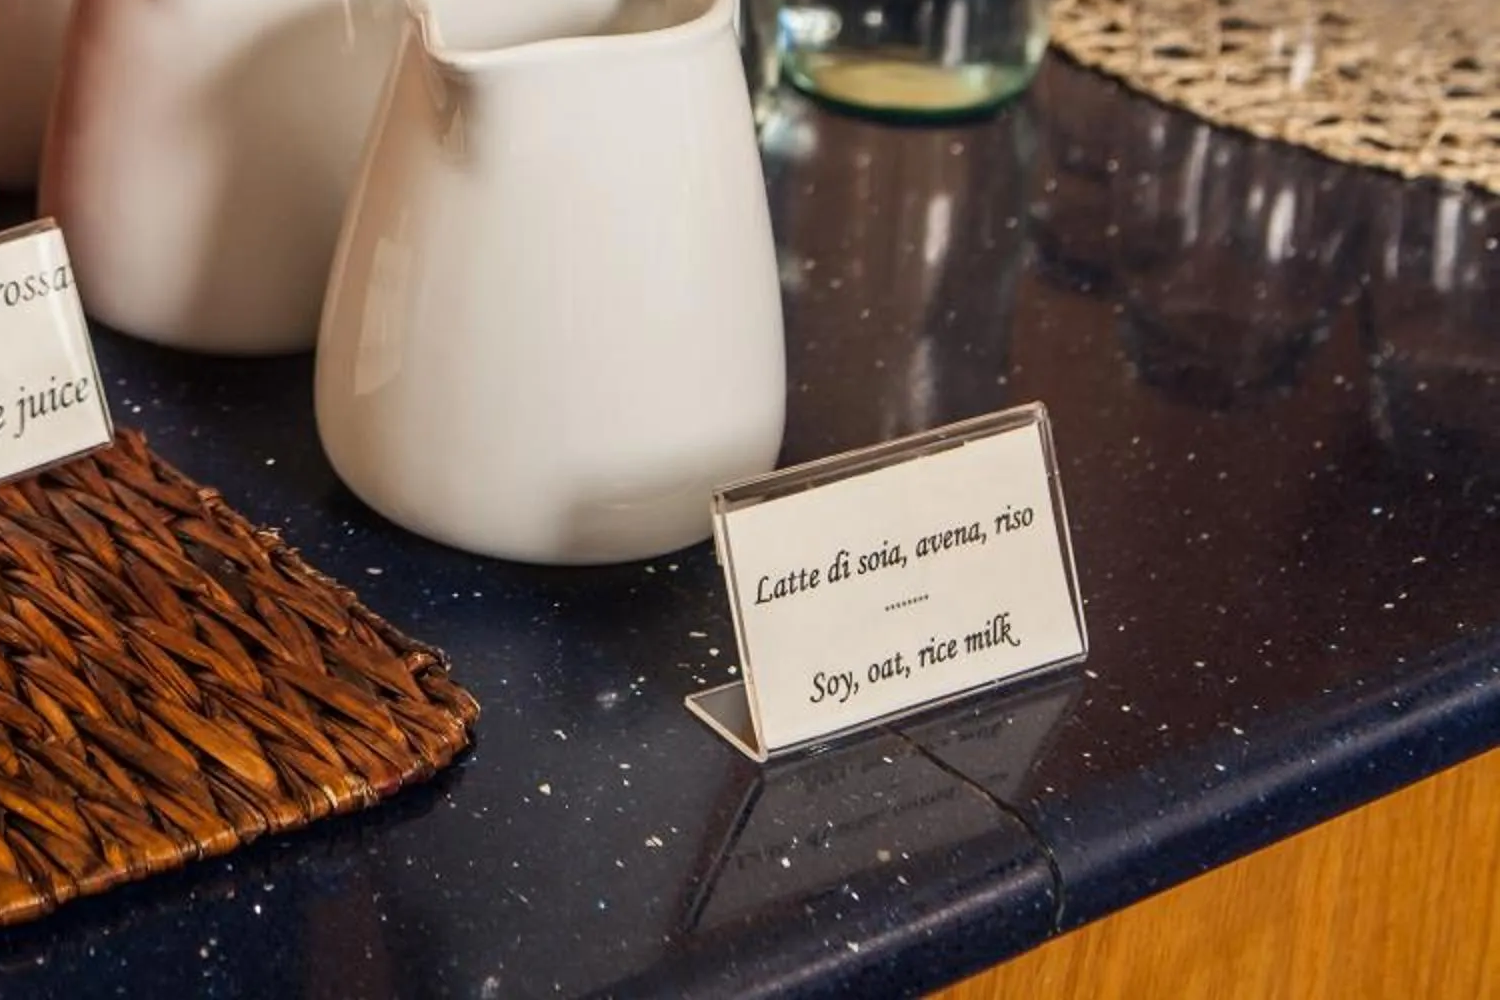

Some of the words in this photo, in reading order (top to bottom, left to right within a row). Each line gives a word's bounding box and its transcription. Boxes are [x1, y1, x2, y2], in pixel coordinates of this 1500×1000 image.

[12, 375, 91, 438] juice
[753, 566, 821, 606] Latte
[826, 550, 852, 584] di
[857, 539, 908, 575] soia,
[915, 519, 988, 559] avena,
[993, 503, 1035, 536] riso
[809, 670, 861, 704] Soy,
[867, 652, 911, 684] oat,
[917, 638, 959, 669] rice
[964, 612, 1022, 654] milk
